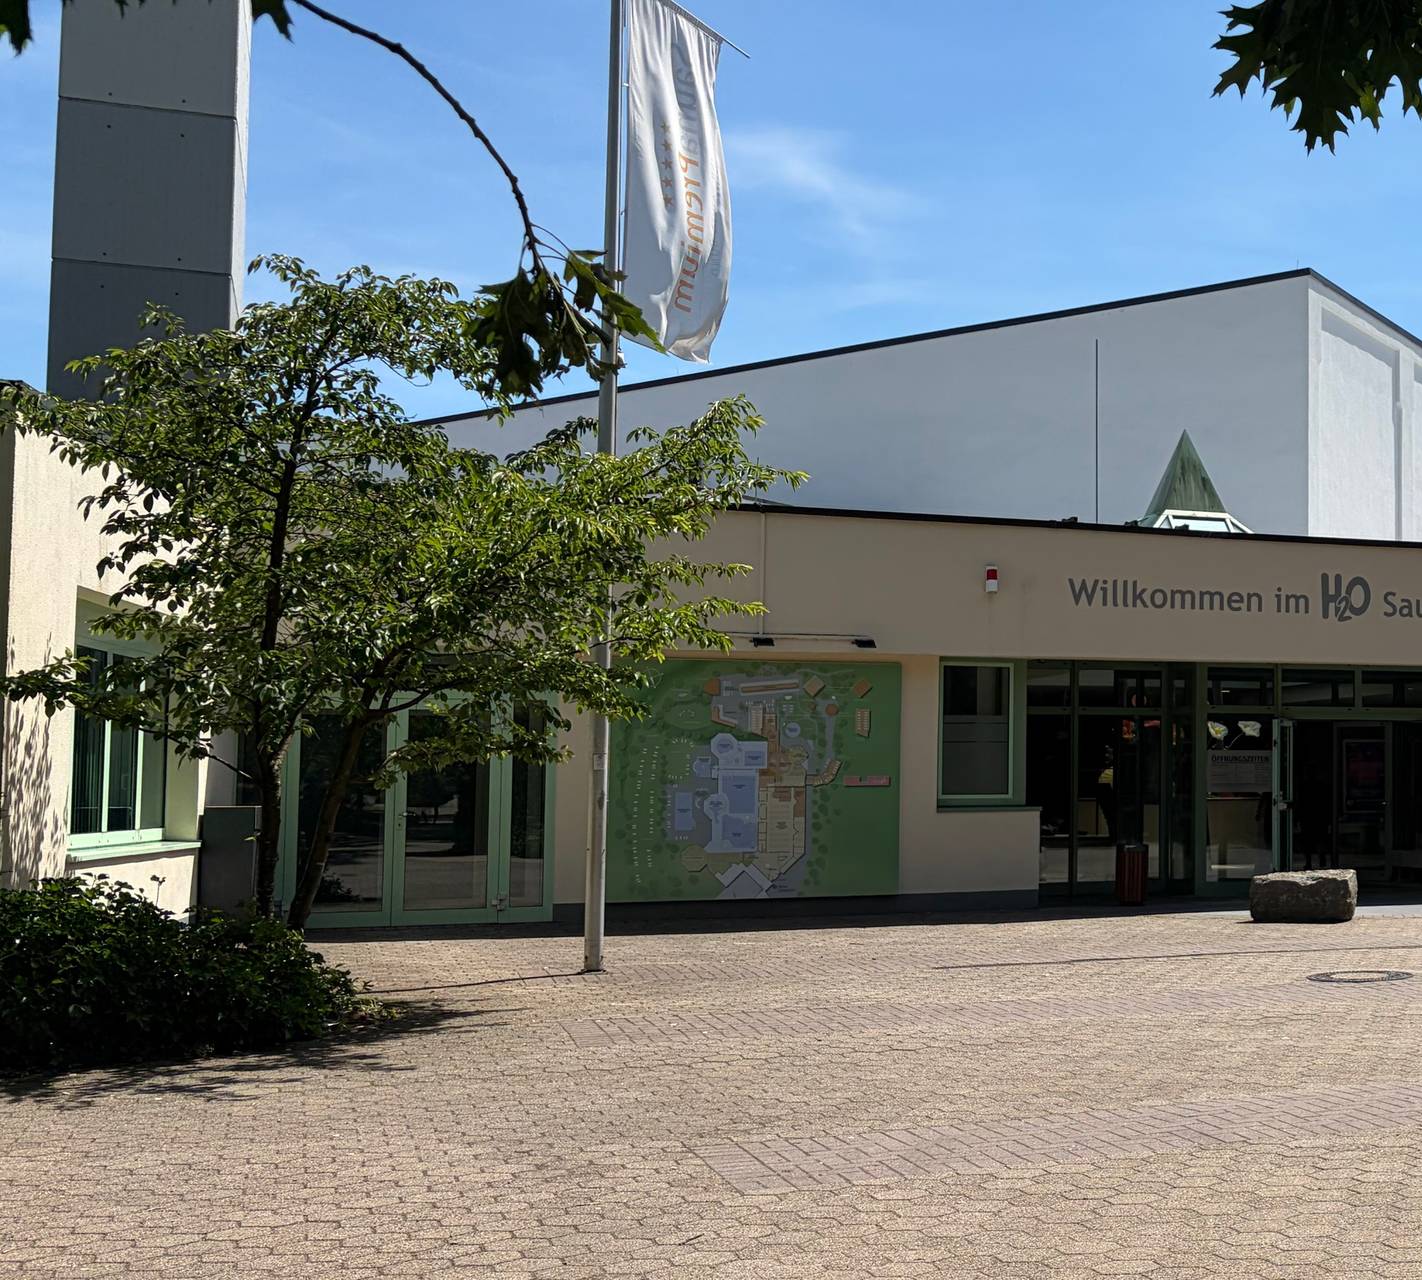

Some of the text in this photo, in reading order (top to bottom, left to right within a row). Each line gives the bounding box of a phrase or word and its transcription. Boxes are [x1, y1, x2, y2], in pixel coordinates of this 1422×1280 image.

[1067, 577, 1263, 613] Willkommen
[1274, 586, 1310, 615] im
[1320, 572, 1372, 623] H2O
